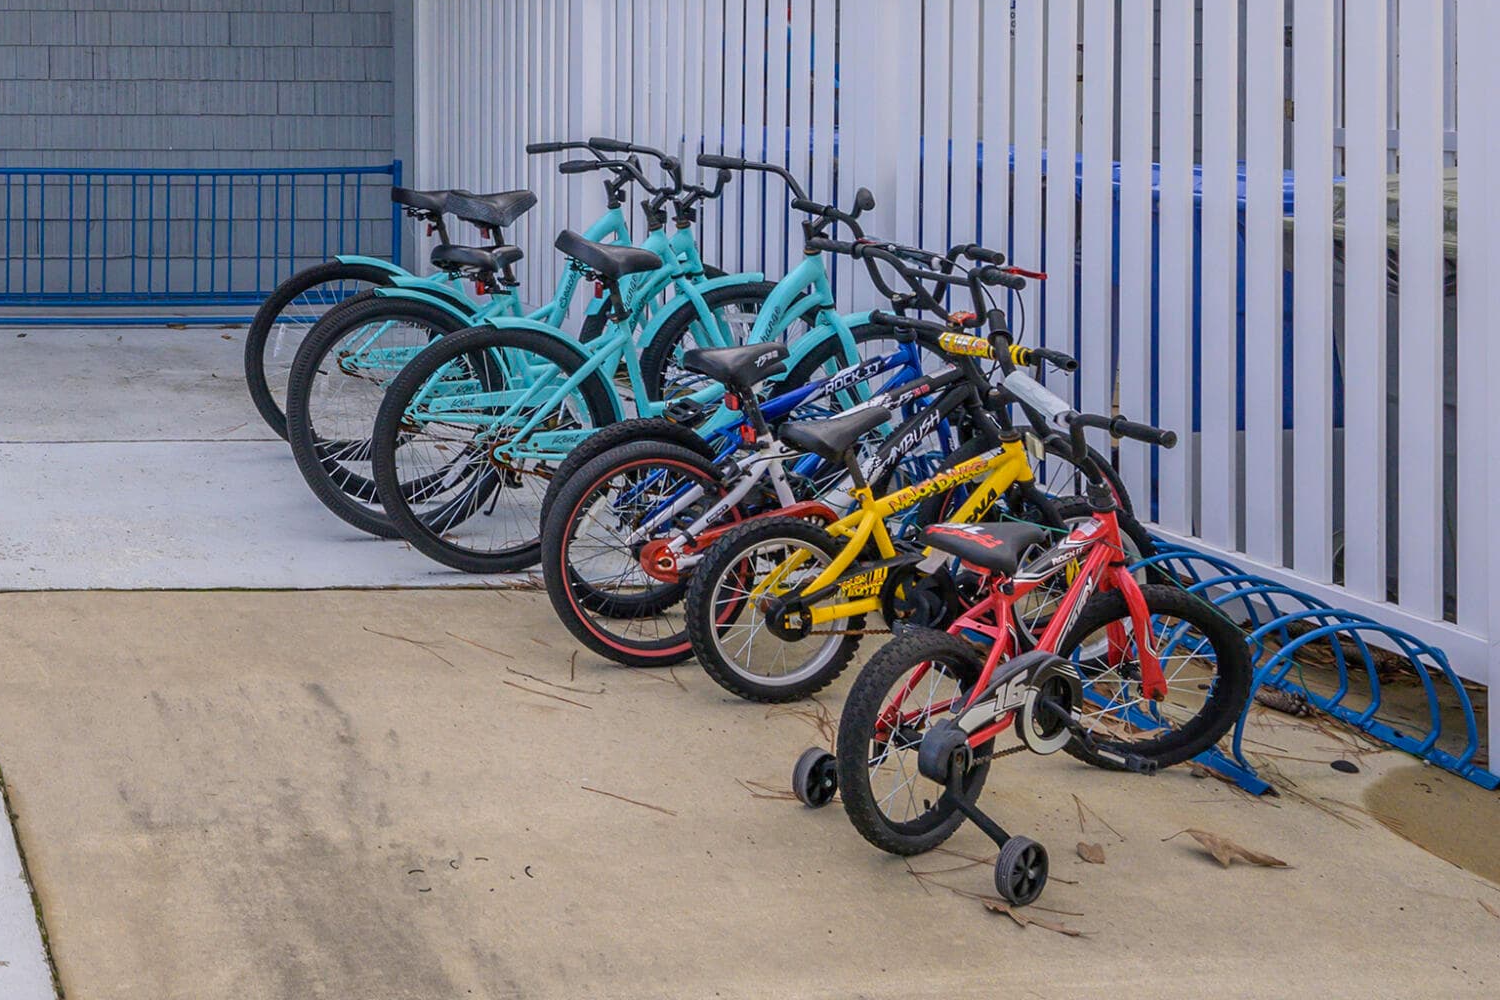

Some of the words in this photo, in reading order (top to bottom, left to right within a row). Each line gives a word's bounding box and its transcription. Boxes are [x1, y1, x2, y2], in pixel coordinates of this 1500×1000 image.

[824, 370, 861, 395] ROCK
[551, 433, 580, 446] Kent
[994, 669, 1029, 712] 16
